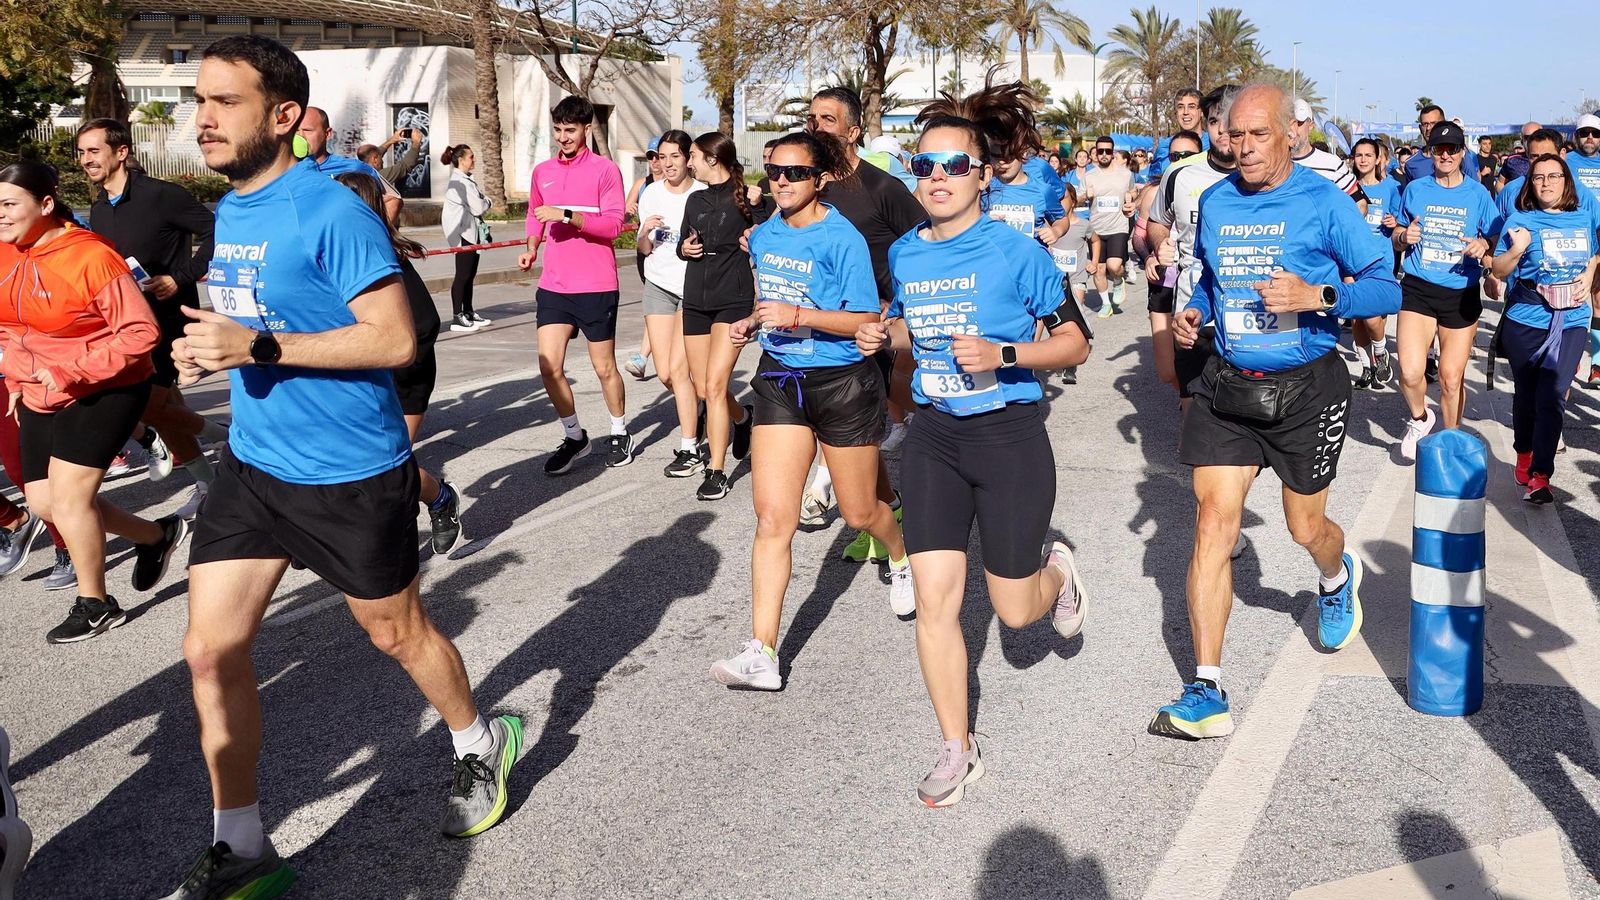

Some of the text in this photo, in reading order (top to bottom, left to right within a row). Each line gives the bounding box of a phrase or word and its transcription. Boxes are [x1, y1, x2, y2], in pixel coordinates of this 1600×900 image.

[1426, 205, 1467, 216] mayoral
[1220, 221, 1286, 240] mayoral
[214, 241, 268, 264] mayoral
[1217, 245, 1280, 257] RUNNING
[1556, 239, 1577, 249] 855
[762, 253, 813, 274] mayoral
[1222, 255, 1274, 266] MAKES
[1218, 265, 1271, 276] FRIENDS
[905, 272, 976, 297] mayoral
[221, 288, 237, 312] 86
[905, 301, 974, 318] RUNNING
[910, 313, 967, 328] MAKES
[1243, 312, 1278, 330] 652
[937, 373, 975, 393] 338
